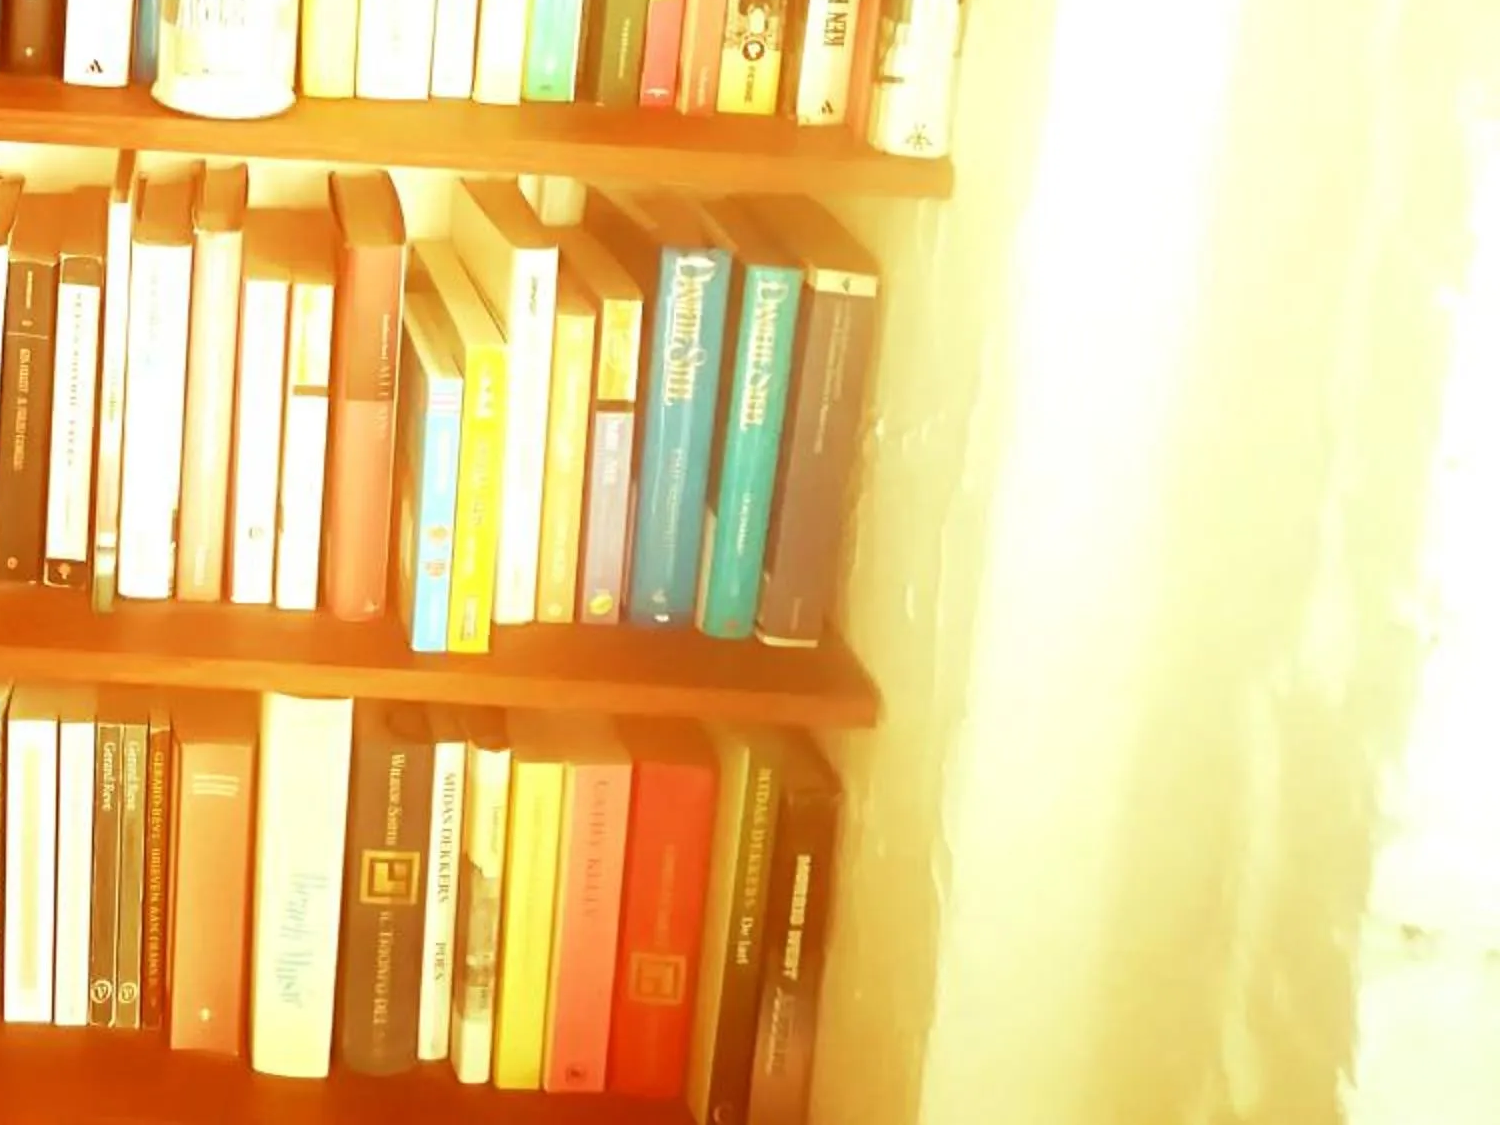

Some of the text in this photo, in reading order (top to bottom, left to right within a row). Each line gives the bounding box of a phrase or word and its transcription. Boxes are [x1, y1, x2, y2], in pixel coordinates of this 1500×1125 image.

[822, 11, 848, 48] KEN
[433, 772, 457, 982] MIDAS DEKKERS POES
[744, 828, 766, 910] DEKKERS
[739, 915, 755, 935] De
[782, 929, 804, 982] WEST
